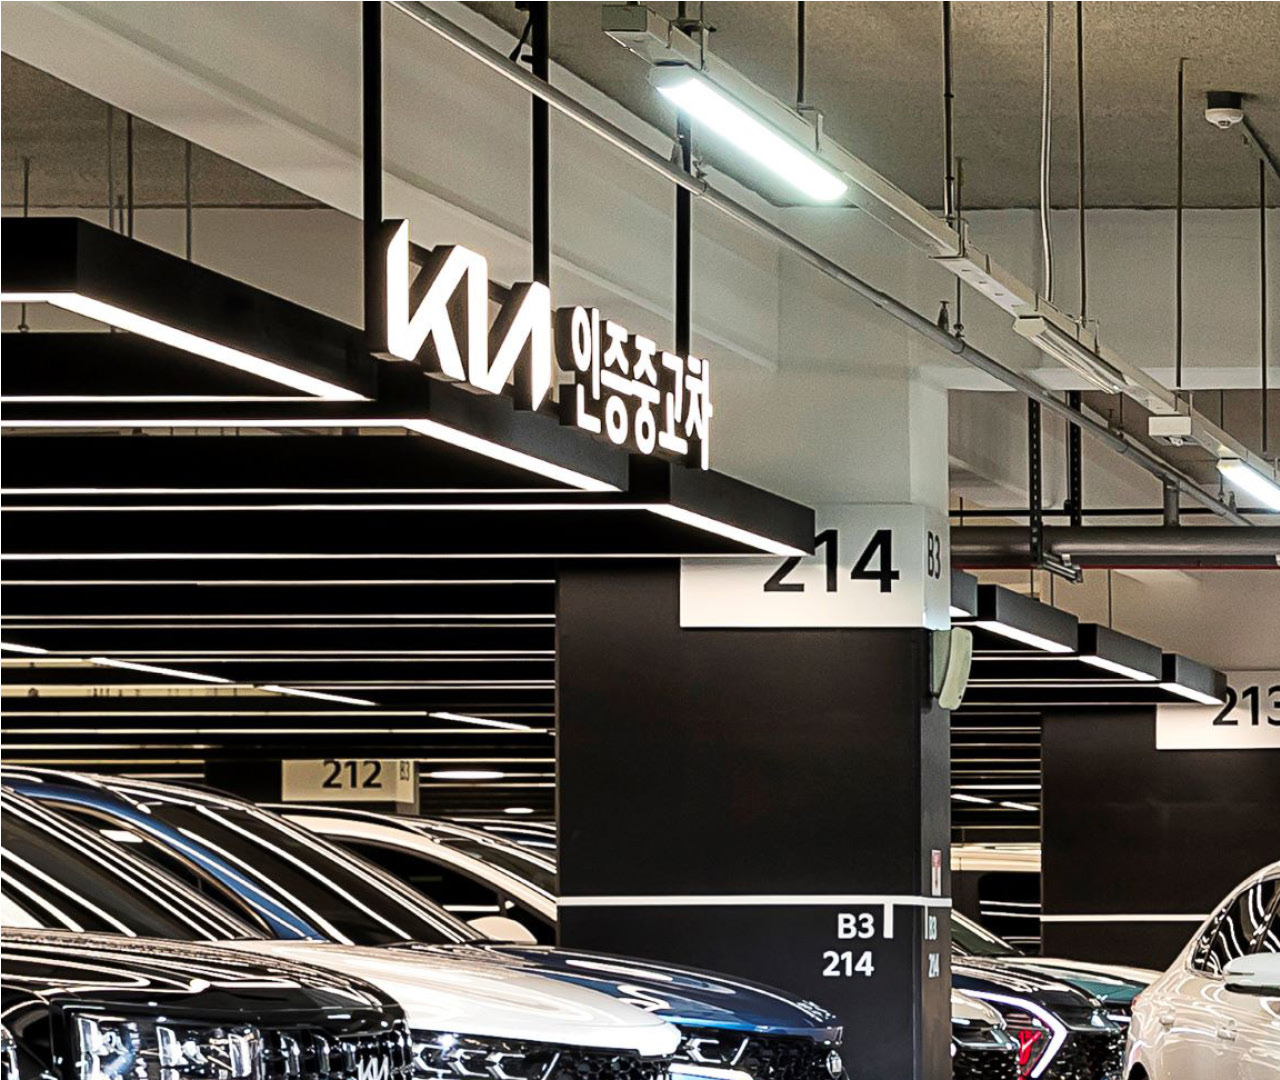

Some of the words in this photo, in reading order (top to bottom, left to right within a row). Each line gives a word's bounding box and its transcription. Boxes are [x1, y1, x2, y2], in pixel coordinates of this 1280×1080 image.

[570, 306, 714, 470] 인증중고차
[927, 530, 942, 580] B3
[321, 760, 383, 789] 212
[837, 912, 875, 939] B3
[822, 951, 875, 978] 214
